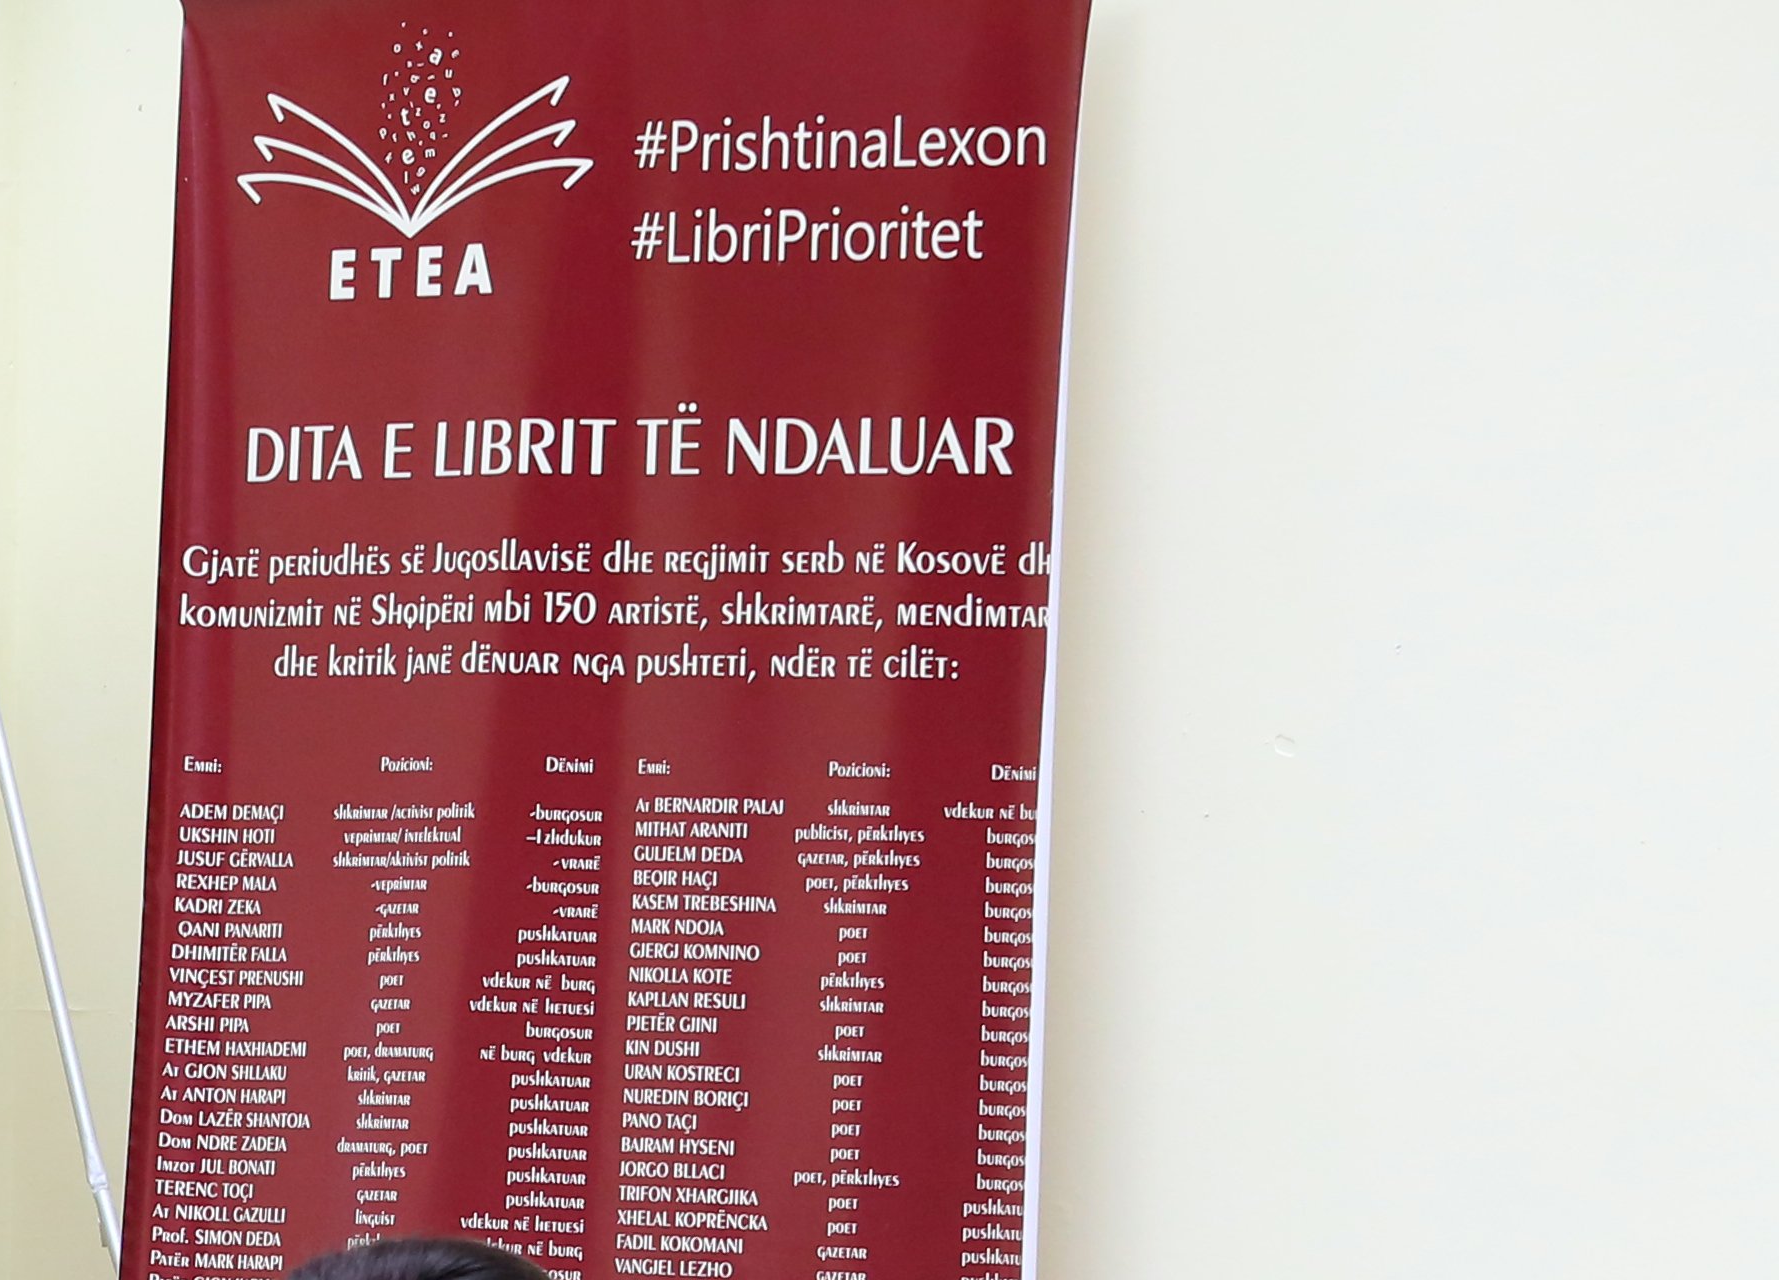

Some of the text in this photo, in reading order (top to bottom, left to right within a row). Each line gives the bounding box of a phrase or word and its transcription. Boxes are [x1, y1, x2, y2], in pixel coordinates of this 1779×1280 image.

[633, 114, 1046, 172] #PrishtinaLexon
[630, 204, 984, 264] #LibriPrioritet
[329, 243, 493, 300] ETEA
[246, 401, 1015, 483] DITA E LIBRIT TË NDALUAR
[182, 544, 260, 585] Gjatë
[268, 542, 391, 585] periudhës
[400, 543, 425, 575] së
[431, 537, 592, 580] Jugosllavisë
[602, 539, 654, 573] dhe
[664, 543, 770, 581] regjimit
[781, 539, 845, 574] serb
[855, 543, 886, 574] në
[897, 541, 1006, 575] Kosovë
[179, 592, 324, 628] komunizmit
[333, 596, 362, 626] në
[371, 591, 474, 632] Shqipëri
[484, 588, 531, 623] mbi
[543, 590, 597, 625] 150
[607, 594, 708, 632] artistë,
[721, 590, 883, 633] shkrimtarë,
[274, 640, 959, 684] dhe kritik janë dënuar nga pushteti, ndër të cilët:
[183, 755, 222, 774] Emri:
[545, 755, 594, 774] Dënimi
[637, 758, 671, 775] Emri:
[828, 760, 891, 778] Pozicioni:
[991, 763, 1036, 781] Dënimi
[179, 803, 284, 825] ADEM DEMAÇI
[743, 798, 784, 815] PALAJ
[179, 826, 275, 845] UKSHIN HOTI
[635, 821, 748, 839] MITHAT ARANITI
[176, 847, 294, 868] JUSUF GËRVALLA
[633, 844, 744, 863] GULJELM DEDA
[176, 872, 277, 892] REXHEP MALA
[633, 869, 718, 892] BEQIR HAÇI
[174, 896, 262, 915] KADRI ZEKA
[632, 893, 777, 913] KASEM TREBESHINA
[177, 920, 283, 939] QANI PANARITI
[630, 917, 725, 936] MARK NDOJA
[171, 942, 287, 963] DHIMITËR FALLA
[629, 941, 761, 962] GJERGJ KOMNINO
[169, 966, 304, 989] VINÇEST PRENUSHI
[628, 966, 733, 985] NIKOLLA KOTE
[167, 990, 272, 1010] MYZAFER PIPA
[627, 990, 746, 1010] KAPLLAN RESULI
[165, 1014, 250, 1033] ARSHI PIPA
[525, 1020, 593, 1043] burgosur
[626, 1011, 718, 1034] PJETËR GJINI
[164, 1037, 307, 1058] ETHEM HAXHIADEMI
[625, 1039, 700, 1057] KIN DUSHI
[181, 1086, 237, 1104] ANTON
[240, 1088, 286, 1105] HARAPI
[623, 1087, 749, 1112] NUREDIN BORIÇI
[622, 1112, 697, 1135] PANO TAÇI
[621, 1136, 735, 1156] BAJRAM HYSENI
[154, 1178, 254, 1204] TERENC TOÇI
[616, 1233, 744, 1255] FADIL KOKOMANI
[614, 1257, 733, 1279] VANGJEL LEZHO
